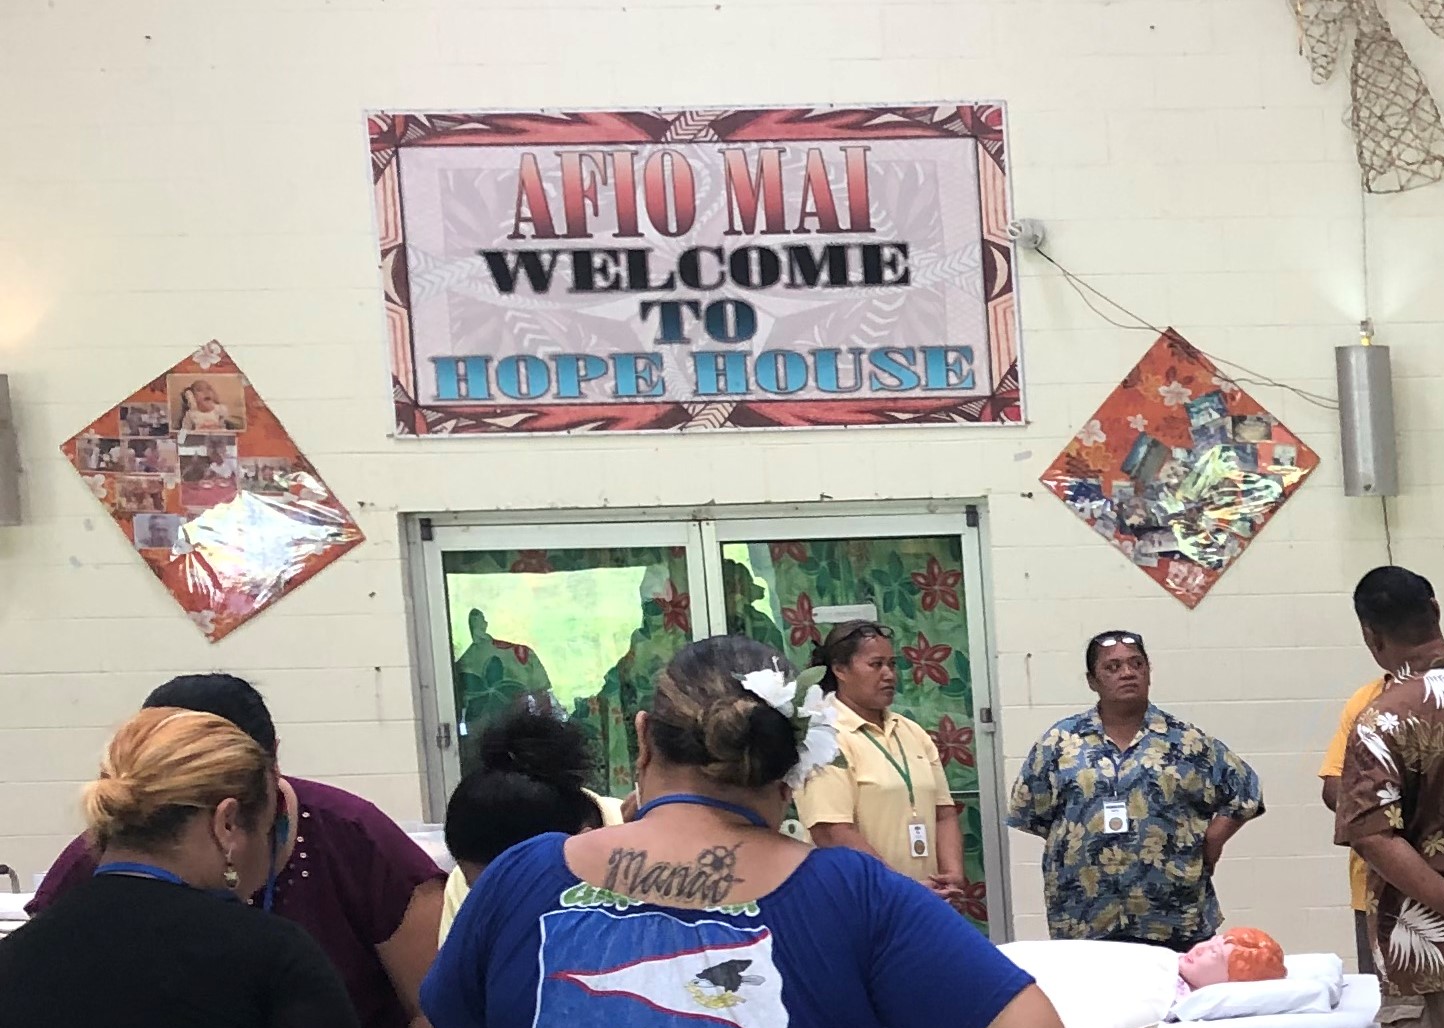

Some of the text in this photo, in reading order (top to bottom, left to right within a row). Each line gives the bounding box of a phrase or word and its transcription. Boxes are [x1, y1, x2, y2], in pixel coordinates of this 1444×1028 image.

[507, 144, 876, 240] AFIO MAI
[480, 242, 910, 295] WELCOME
[638, 297, 758, 345] TO
[430, 344, 976, 402] HOPE HOUSE
